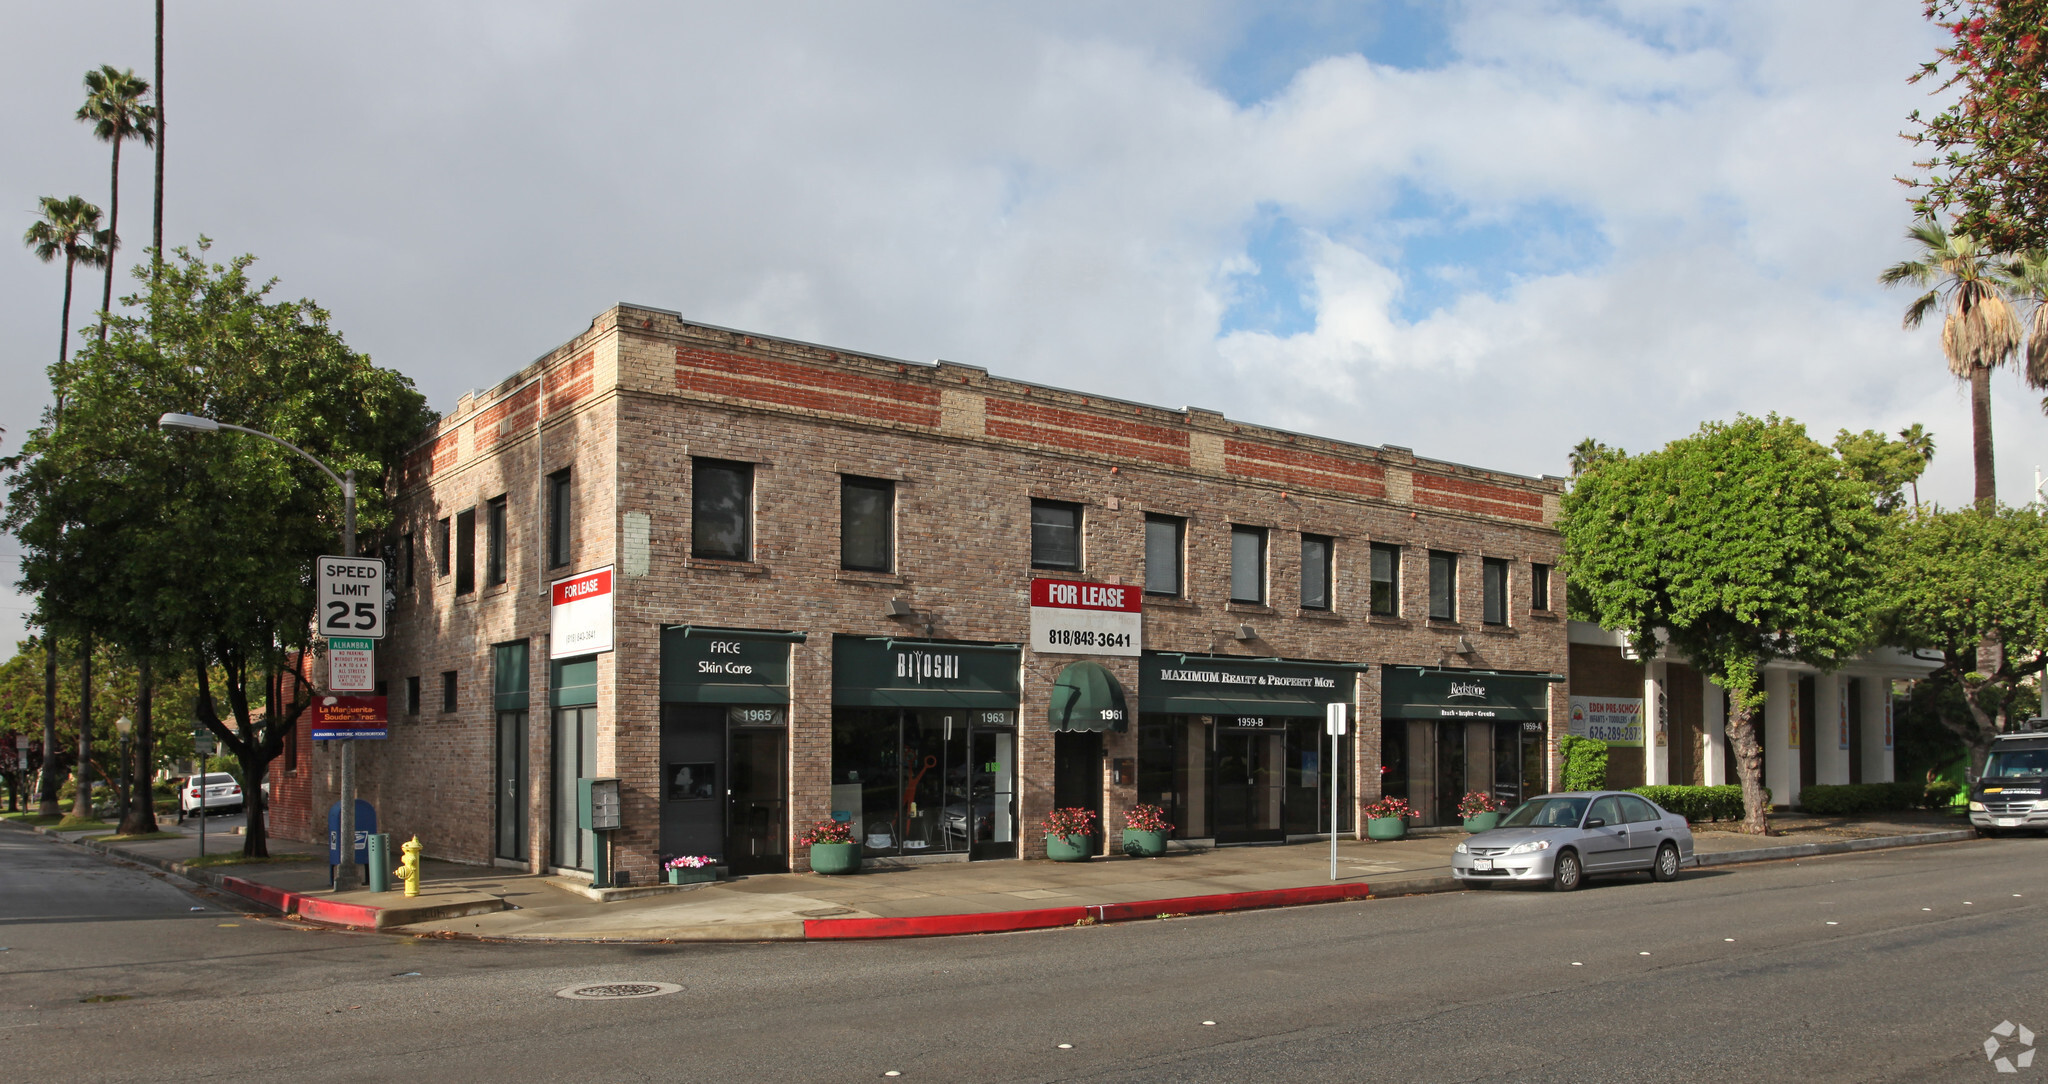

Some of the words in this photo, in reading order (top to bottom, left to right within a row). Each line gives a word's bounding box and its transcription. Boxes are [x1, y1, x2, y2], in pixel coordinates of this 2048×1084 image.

[326, 564, 377, 579] SPEED
[332, 583, 370, 597] LIMIT
[564, 583, 578, 599] FOR
[577, 578, 599, 596] LEASE
[1048, 583, 1078, 606] FOR
[1082, 585, 1126, 609] LEASE
[326, 600, 377, 631] 25
[333, 641, 369, 649] ALHAMBRA
[1049, 629, 1131, 648] 818/843-3641
[710, 641, 740, 655] FACE
[698, 660, 723, 674] Skin
[725, 662, 752, 675] Care
[897, 650, 959, 684] BIYOSHI
[1161, 669, 1220, 683] MAXIMUM
[1221, 673, 1257, 685] REALTY
[1258, 676, 1266, 685] &
[1267, 674, 1313, 687] PROPERTY
[1589, 702, 1604, 713] EDEN
[743, 709, 772, 722] 1965
[981, 712, 1004, 724] 1963
[1100, 710, 1124, 721] 1961
[1237, 717, 1264, 727] 1959-B
[1522, 722, 1542, 731] 1959-A
